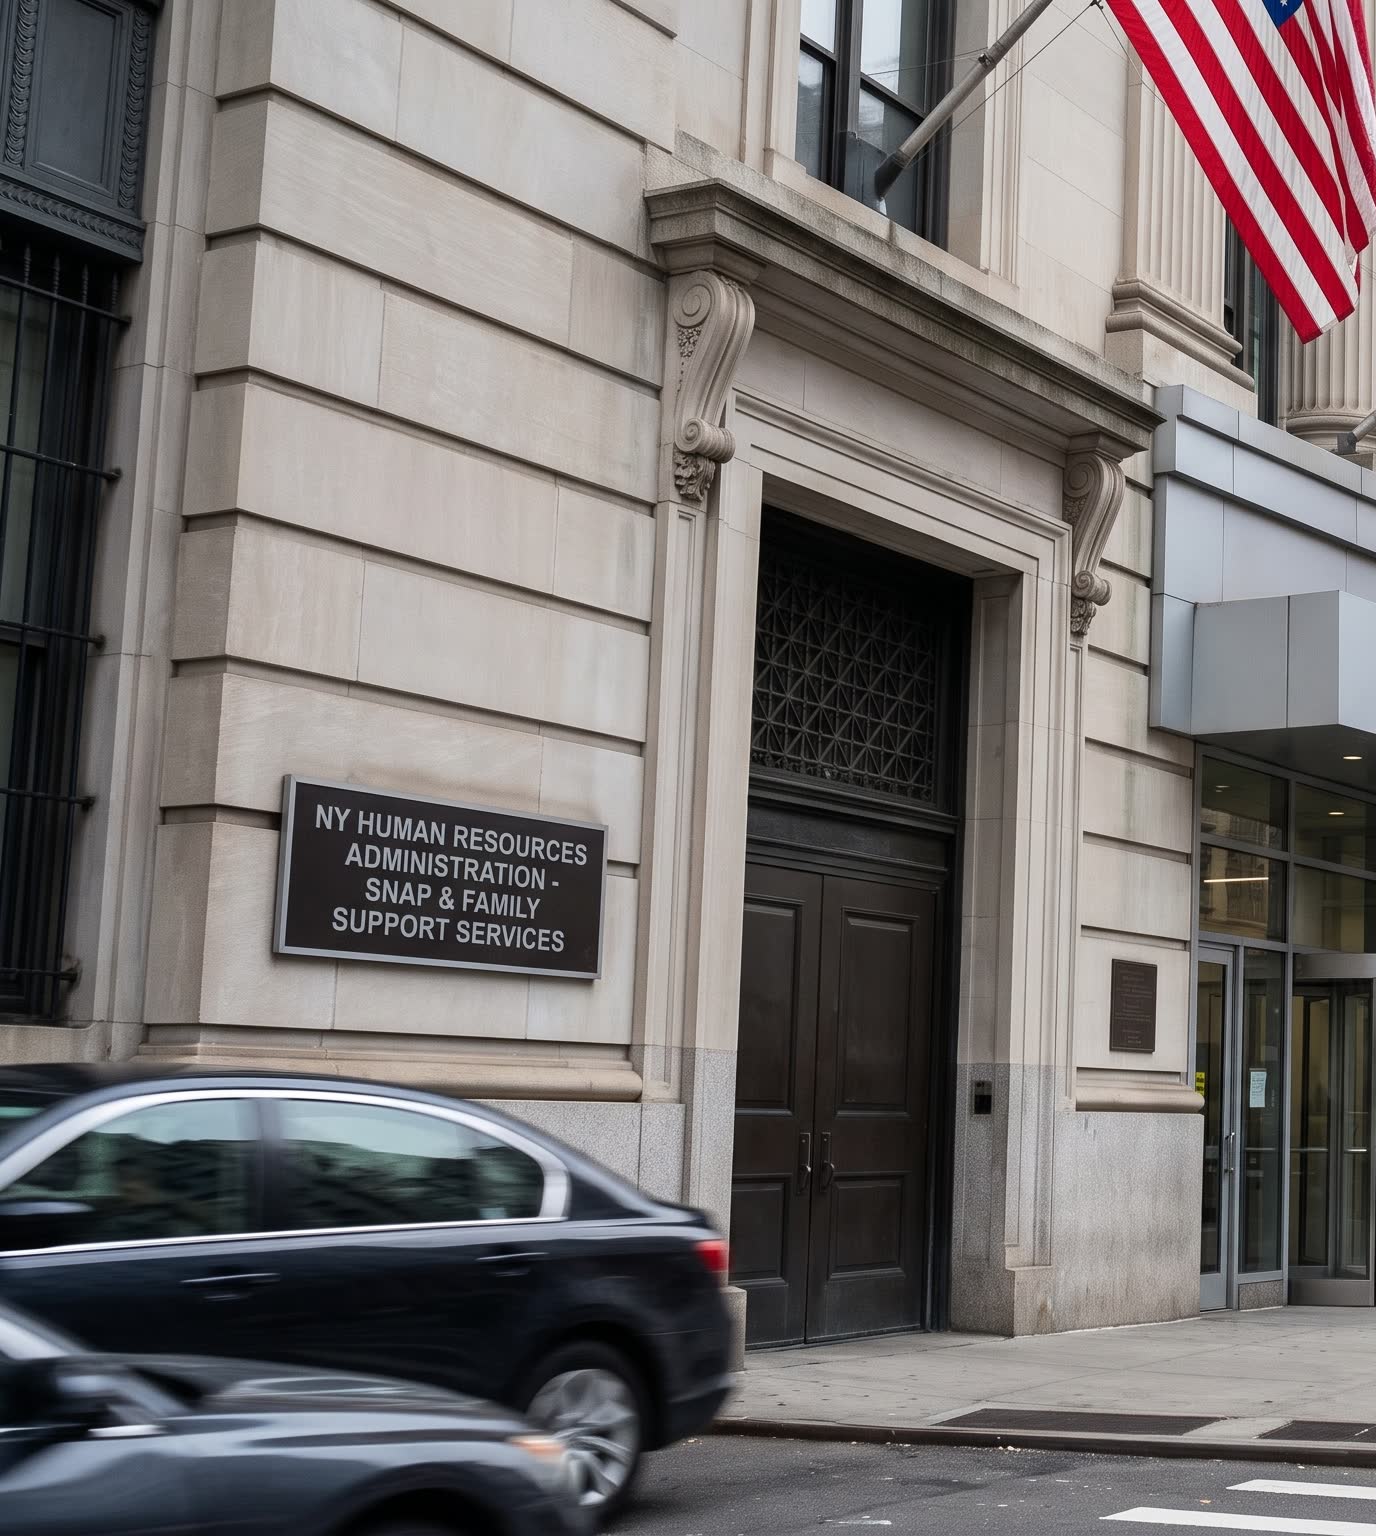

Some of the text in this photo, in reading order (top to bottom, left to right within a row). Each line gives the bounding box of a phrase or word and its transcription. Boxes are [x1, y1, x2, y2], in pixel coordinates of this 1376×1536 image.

[315, 804, 588, 866] NY HUMAN RESOURCES
[344, 842, 546, 890] ADMINISTRATION
[364, 877, 541, 920] SNAP & FAMILY
[332, 906, 565, 953] SUPPORT SERVICES
